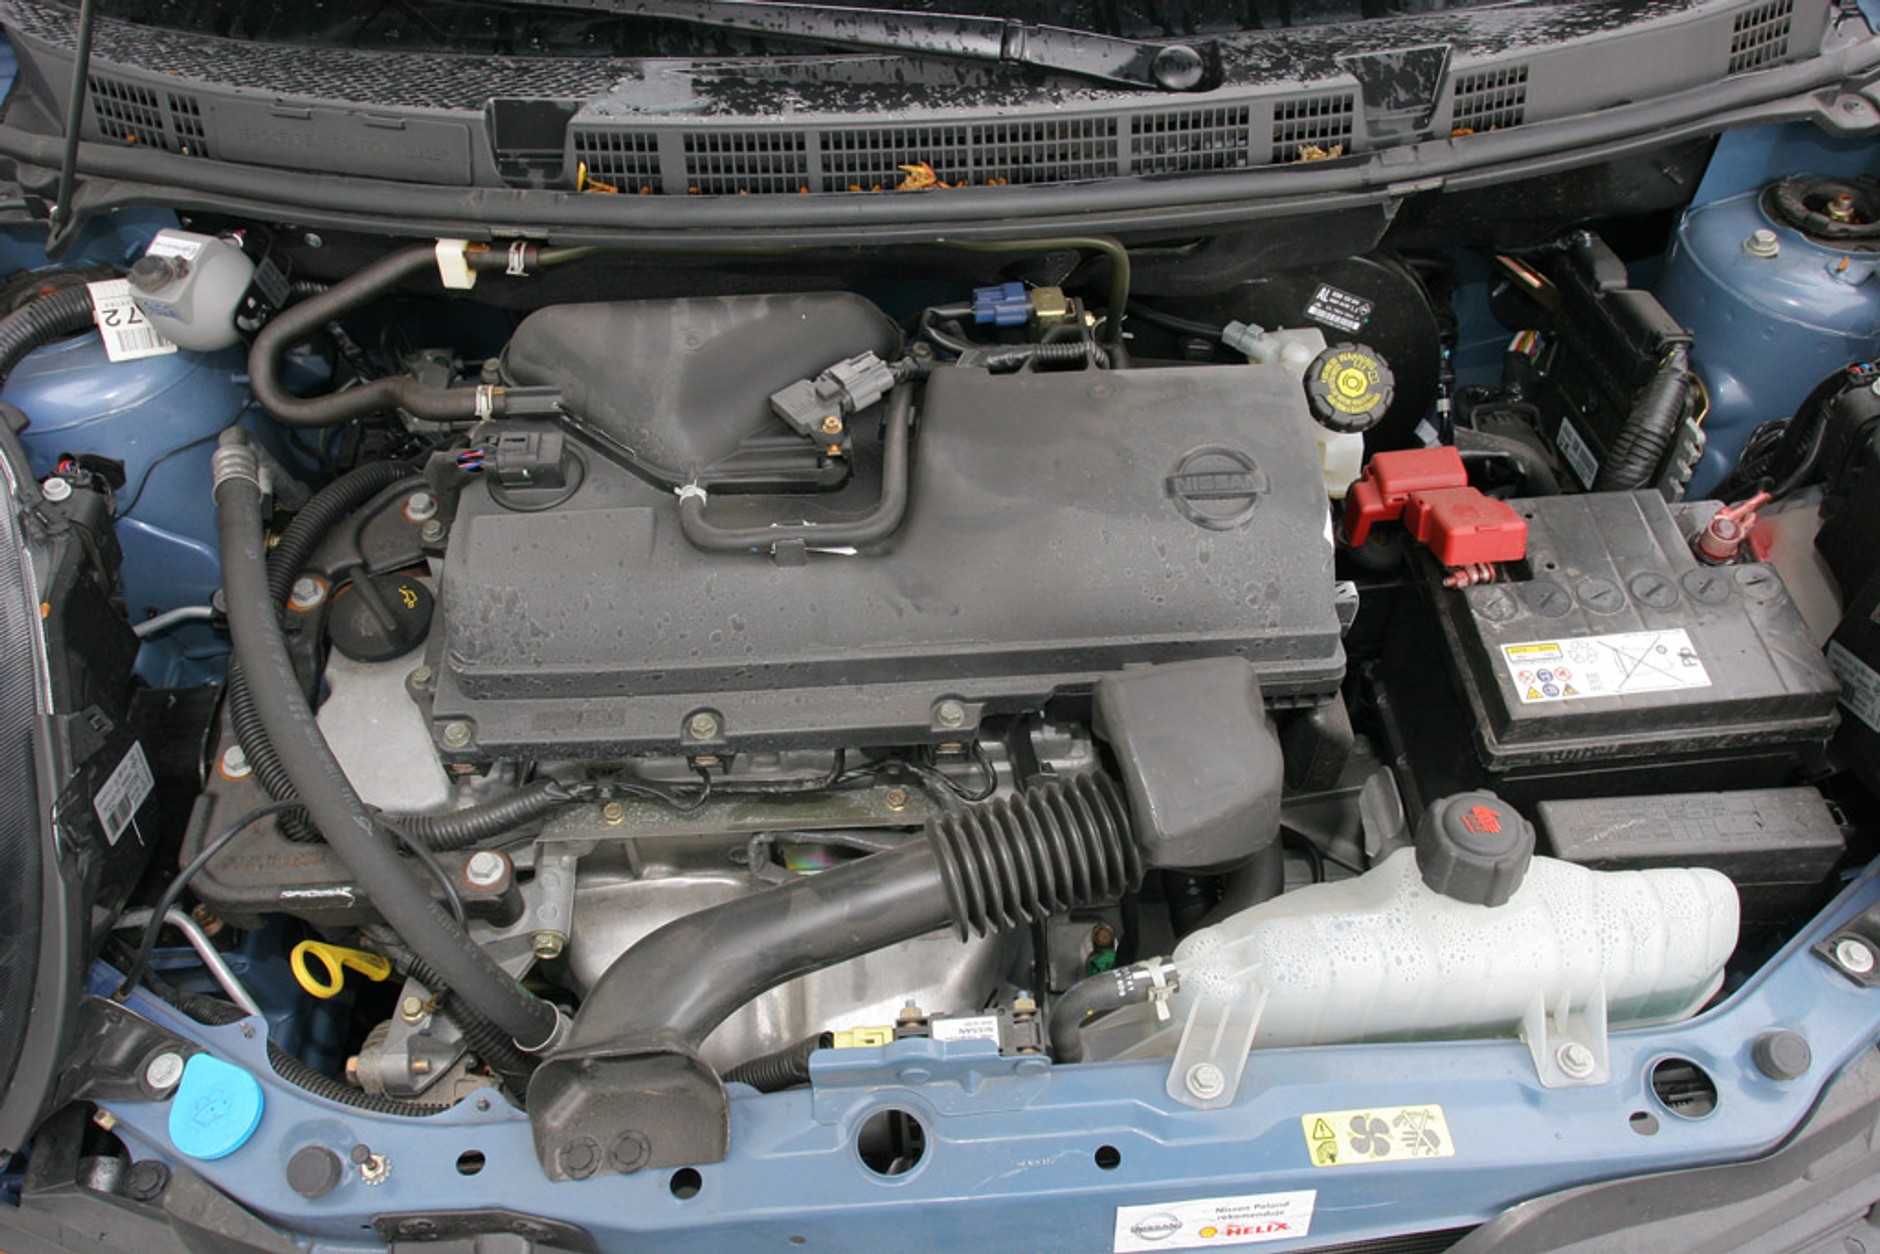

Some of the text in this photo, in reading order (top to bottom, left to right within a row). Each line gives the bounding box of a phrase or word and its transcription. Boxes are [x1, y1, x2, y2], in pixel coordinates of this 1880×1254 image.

[102, 306, 142, 327] 72
[1174, 474, 1260, 492] NISSAN
[1215, 1200, 1290, 1213] Nissan Poland
[1217, 1209, 1285, 1220] rekomenduje
[1226, 1221, 1289, 1237] HELIX
